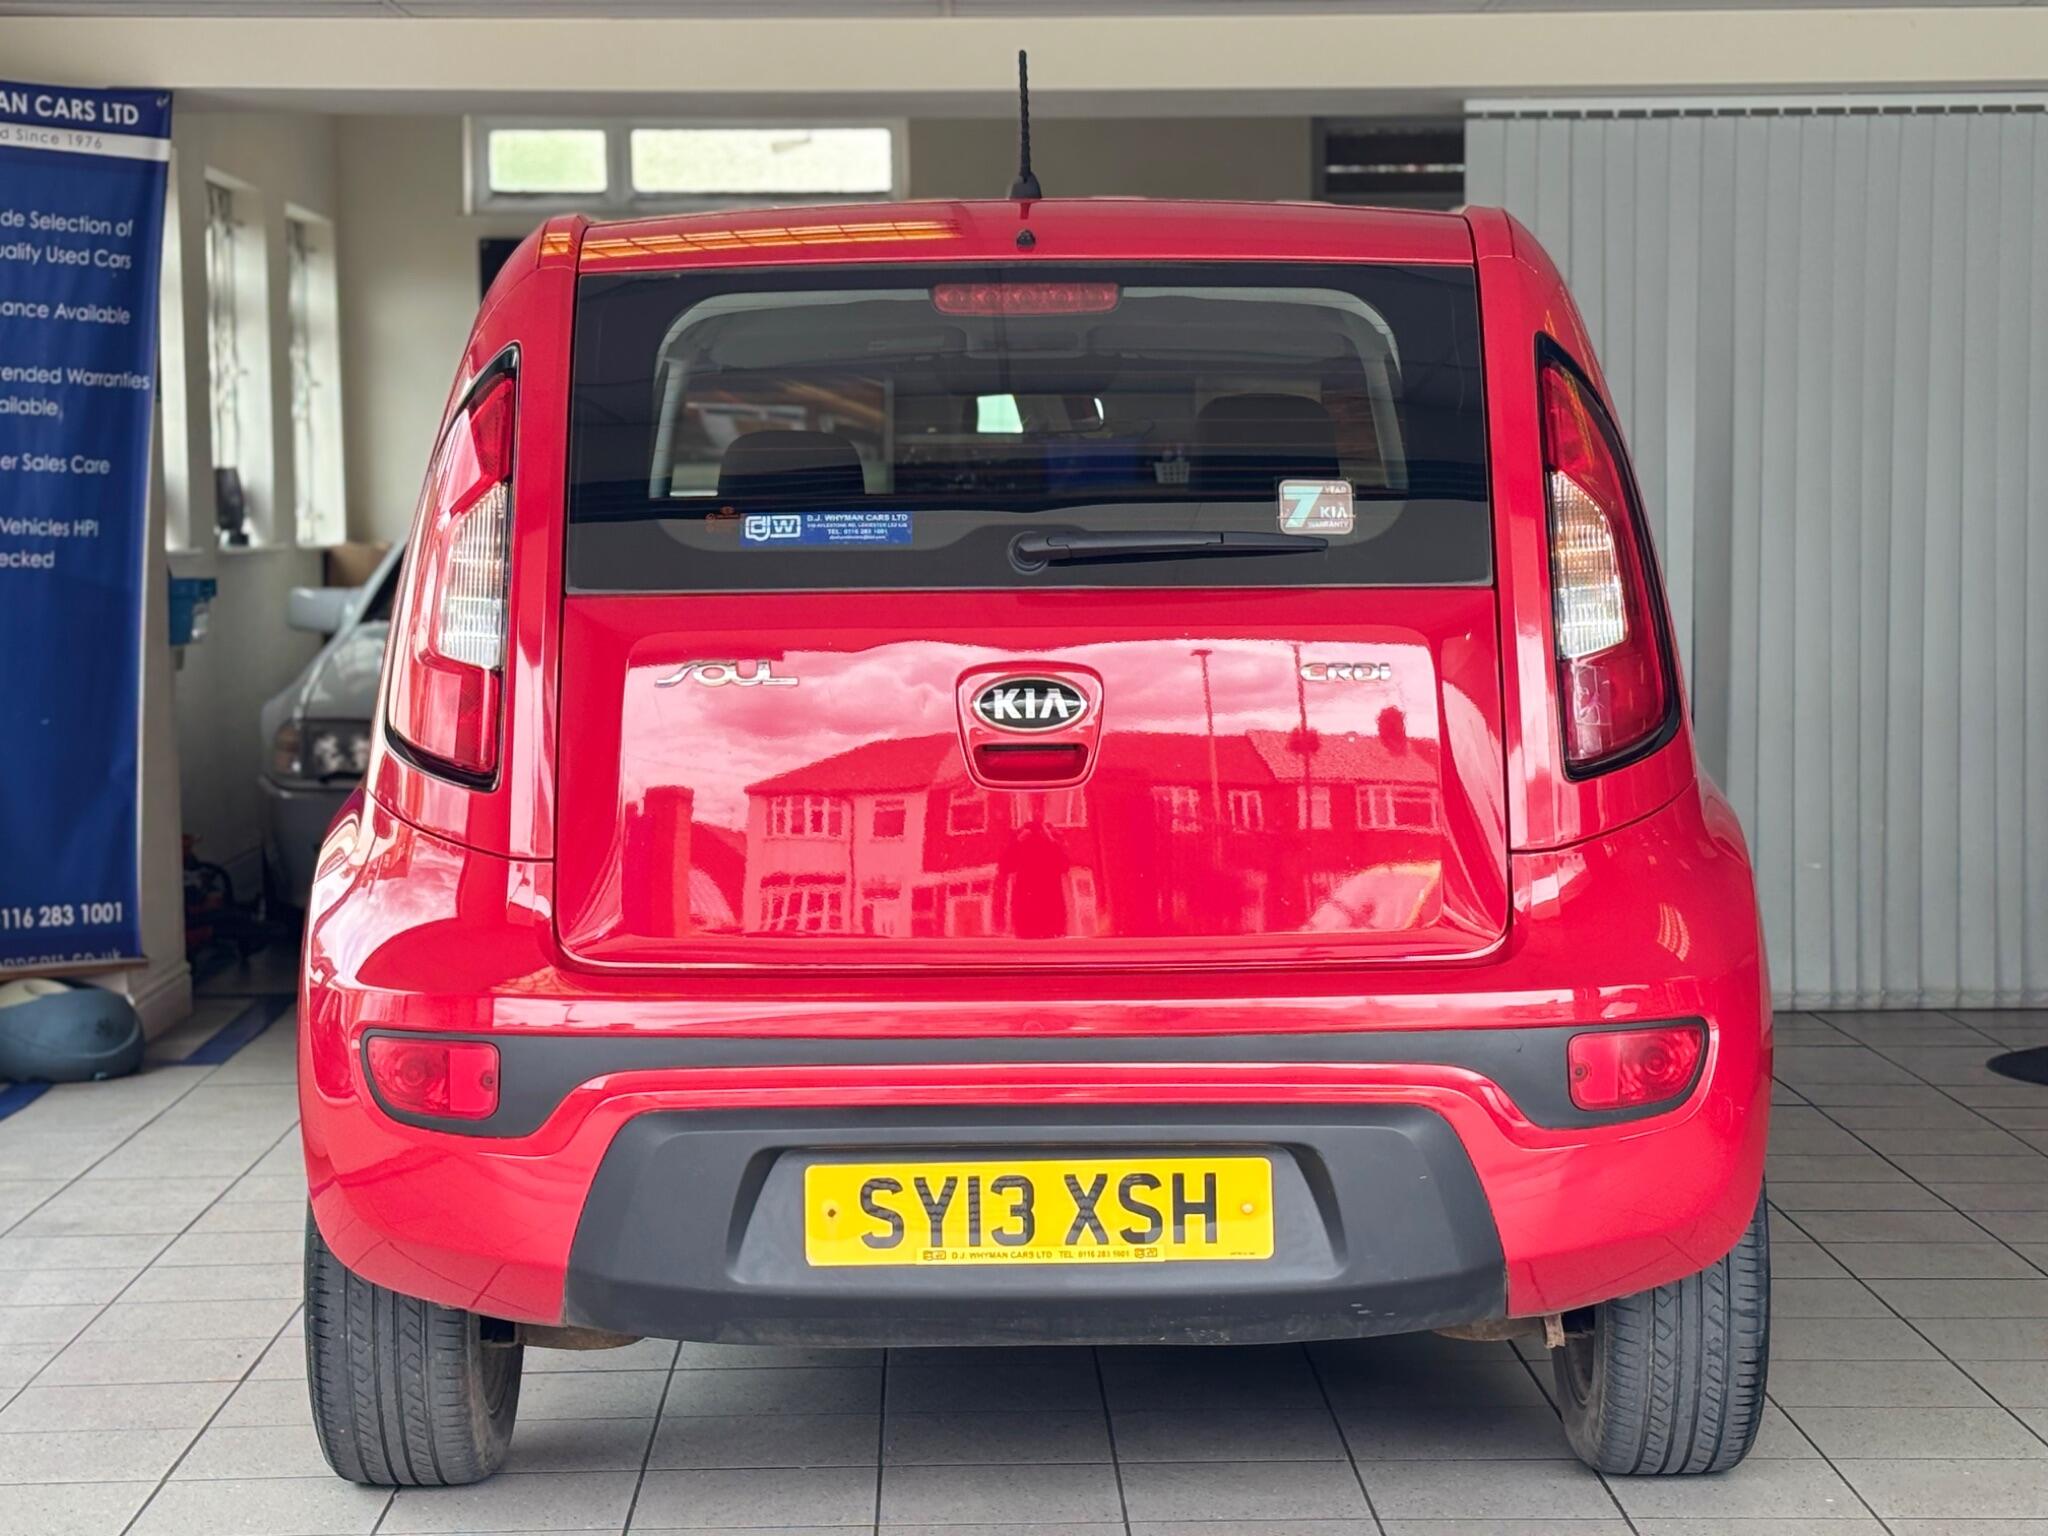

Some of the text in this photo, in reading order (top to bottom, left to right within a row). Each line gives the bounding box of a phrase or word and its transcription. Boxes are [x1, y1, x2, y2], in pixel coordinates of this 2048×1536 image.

[34, 94, 96, 122] CARS
[102, 102, 139, 125] LTD
[16, 128, 60, 145] Since
[67, 133, 102, 150] 1976
[0, 209, 134, 237] de Selection of
[46, 245, 90, 266] Used
[94, 248, 132, 270] Cars
[54, 303, 131, 325] Available
[66, 367, 150, 390] Warranties
[22, 452, 68, 473] Sales
[70, 454, 110, 474] Care
[1283, 485, 1323, 528] 7
[1320, 505, 1348, 518] KIA
[0, 516, 99, 537] Vehicles HPI
[654, 659, 799, 688] SOUL
[993, 688, 1069, 719] KIA
[39, 904, 75, 928] 283
[81, 901, 122, 925] 1001
[860, 1172, 1217, 1249] SY13 XSH
[969, 1250, 1009, 1260] WHYMAN
[1010, 1250, 1034, 1259] CARS
[1036, 1250, 1053, 1259] LTD
